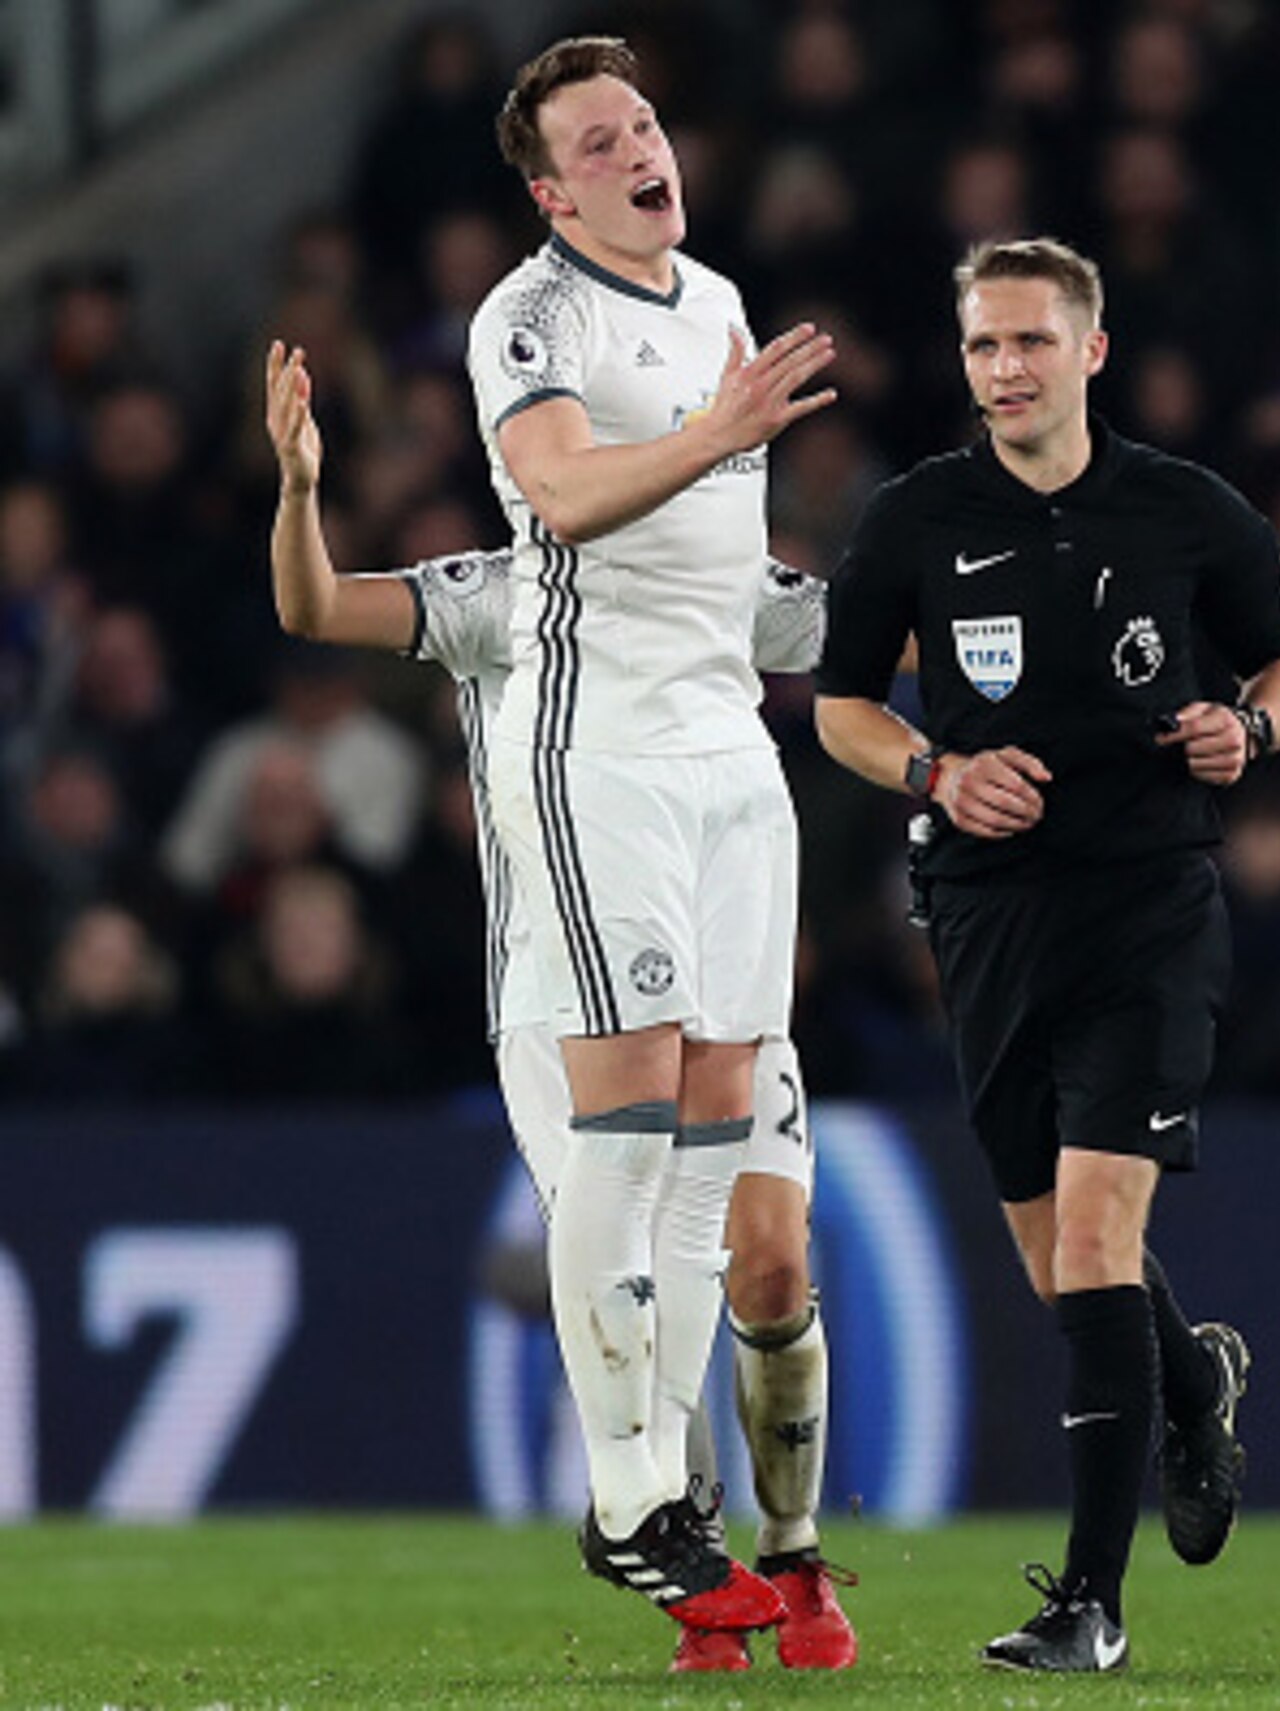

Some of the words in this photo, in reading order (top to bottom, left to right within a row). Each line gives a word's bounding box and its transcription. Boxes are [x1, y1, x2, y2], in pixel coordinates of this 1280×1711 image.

[965, 649, 1014, 667] FIFA
[776, 1072, 803, 1145] 2
[0, 1225, 302, 1523] 7
